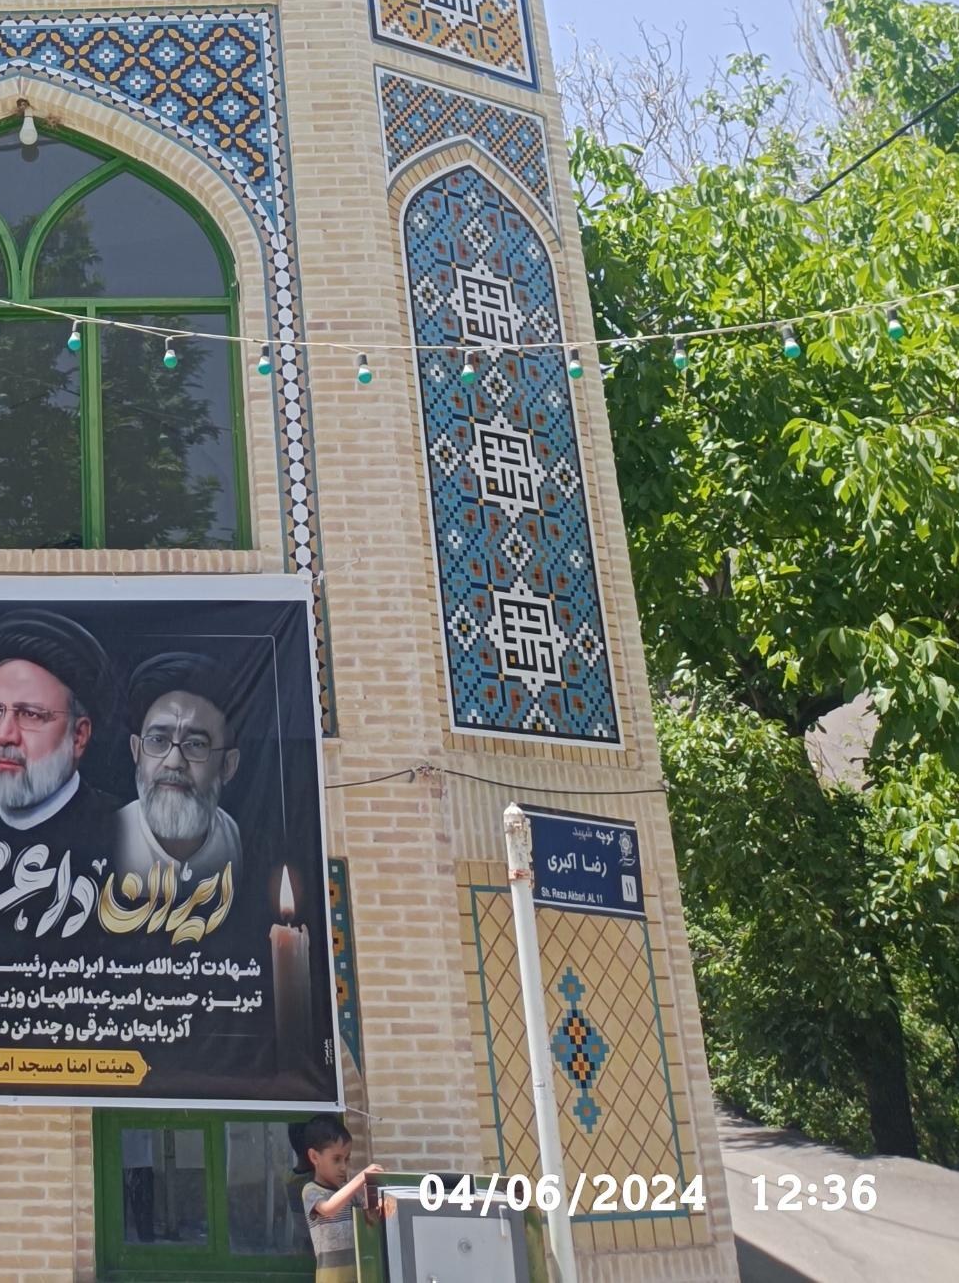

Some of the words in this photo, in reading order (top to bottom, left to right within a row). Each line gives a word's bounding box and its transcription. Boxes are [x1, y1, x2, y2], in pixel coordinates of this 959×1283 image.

[595, 830, 615, 846] کوچه
[547, 852, 577, 874] اکبری
[581, 853, 608, 878] رضا
[98, 860, 235, 946] ایران
[552, 888, 567, 900] Reza
[48, 956, 104, 979] ابراهیم
[106, 957, 144, 979] سید
[201, 957, 261, 981] شهادت
[144, 989, 199, 1011] حسین
[10, 1018, 31, 1041] تن
[32, 1018, 64, 1044] چند
[64, 1023, 75, 1041] و
[76, 1012, 119, 1042] شرقی
[120, 1013, 193, 1043] آذربایجان
[17, 1059, 63, 1077] مسجد
[66, 1057, 92, 1074] امنا
[95, 1057, 136, 1078] هیئت
